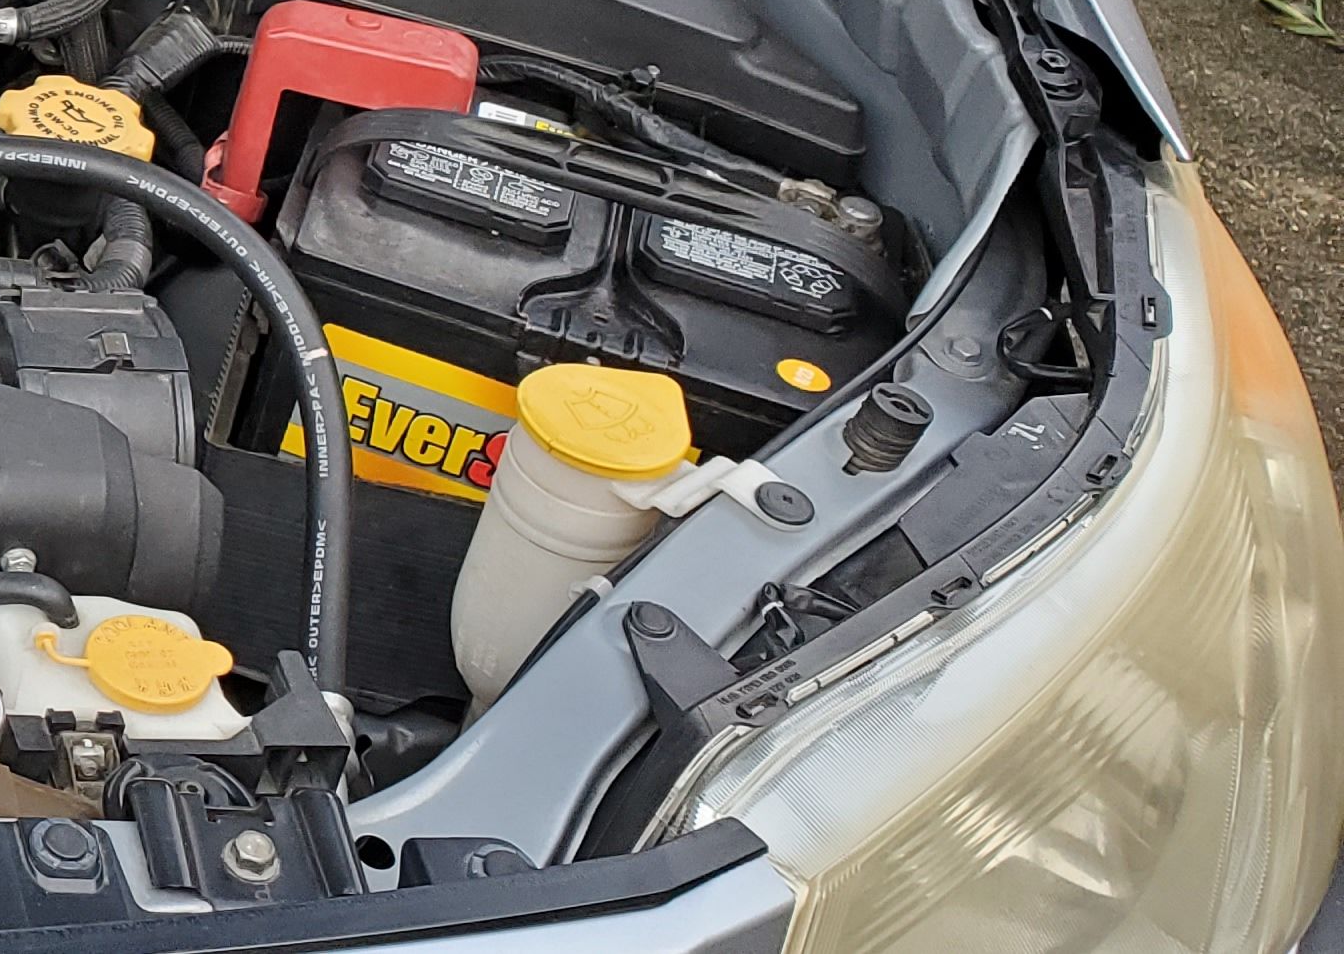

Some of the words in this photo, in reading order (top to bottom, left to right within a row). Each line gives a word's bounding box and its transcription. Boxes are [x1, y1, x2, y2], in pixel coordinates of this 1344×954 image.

[35, 90, 58, 103] SEE
[64, 89, 117, 113] ENGINE
[112, 114, 124, 129] OIL
[28, 102, 63, 141] OWNER'S
[44, 112, 79, 136] 5W-30
